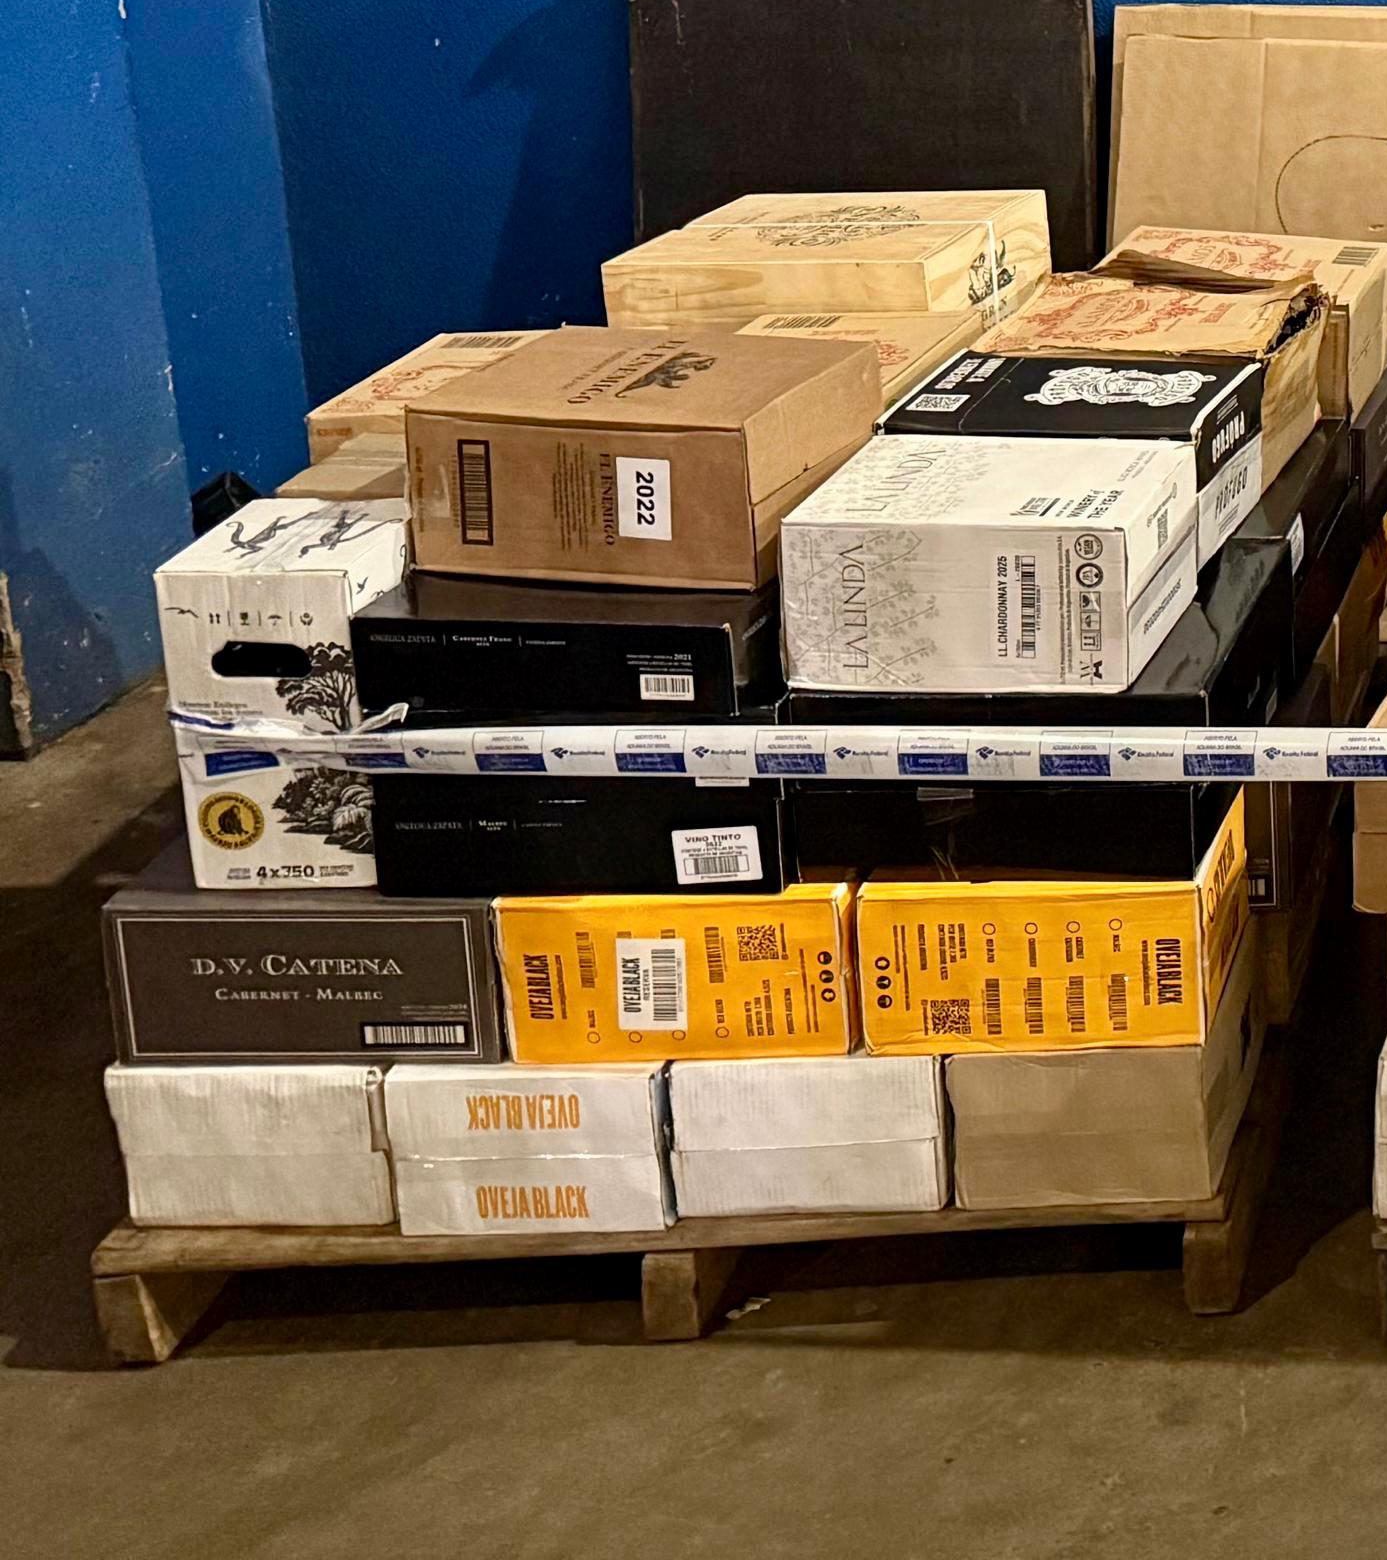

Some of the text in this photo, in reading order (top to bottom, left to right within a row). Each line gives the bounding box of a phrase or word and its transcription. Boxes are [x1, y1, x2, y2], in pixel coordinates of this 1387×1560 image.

[635, 471, 656, 527] 2022
[839, 544, 867, 628] LINDA
[685, 835, 709, 843] VINO
[191, 955, 404, 975] D.V. CATENA
[215, 988, 383, 1000] CABERNET MALBEC
[466, 1095, 523, 1130] BLACK
[531, 1185, 590, 1219] BLACK
